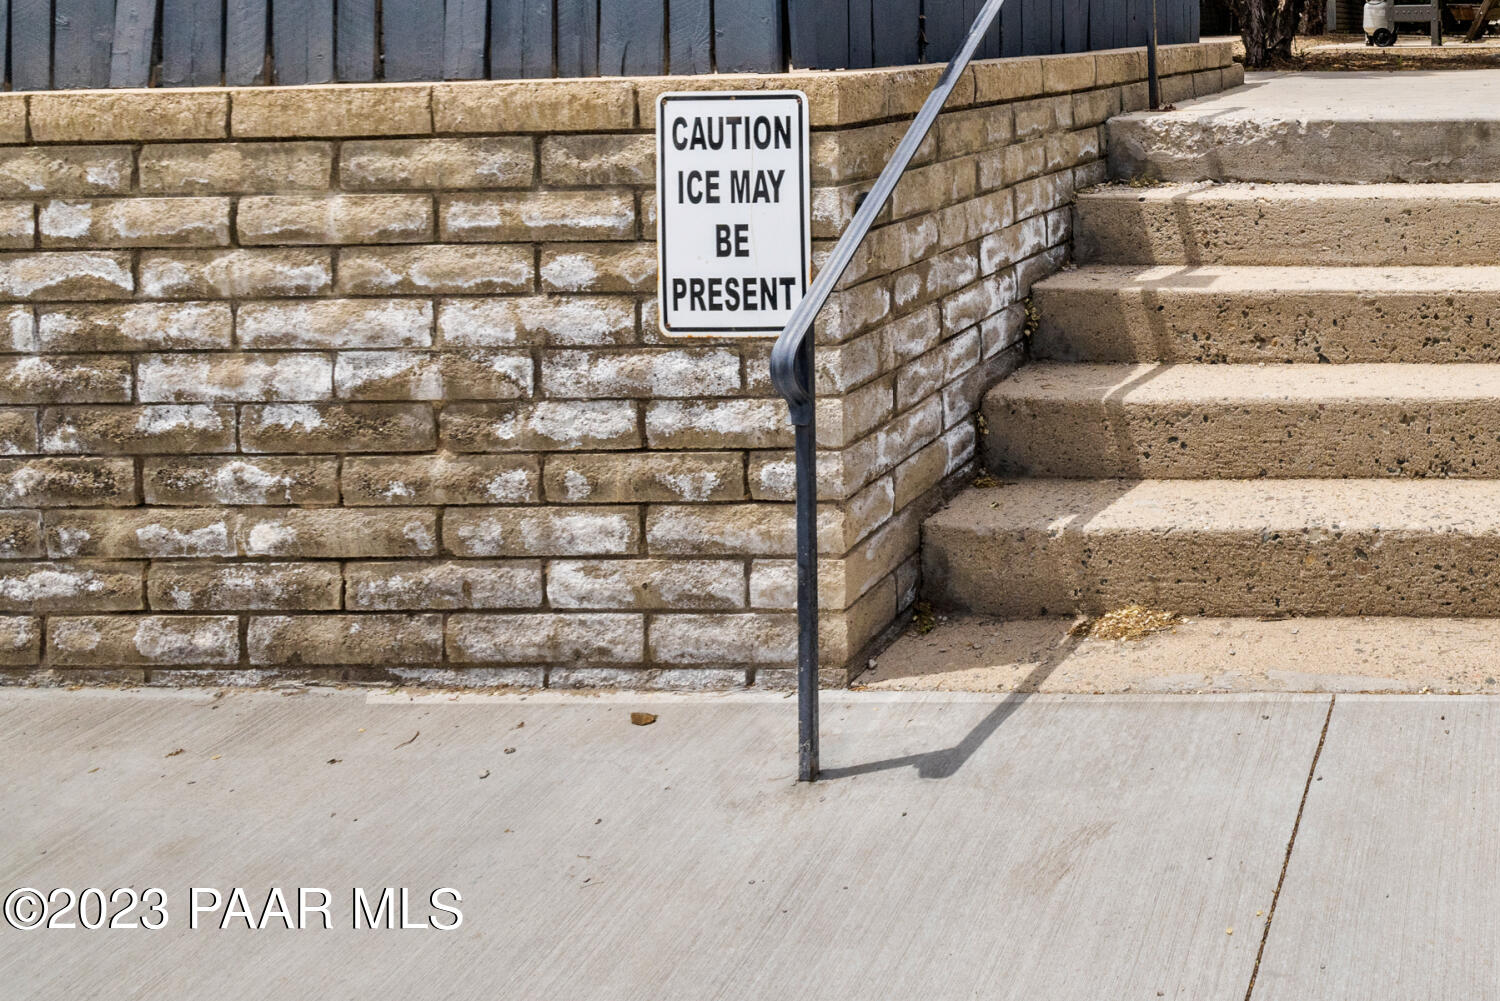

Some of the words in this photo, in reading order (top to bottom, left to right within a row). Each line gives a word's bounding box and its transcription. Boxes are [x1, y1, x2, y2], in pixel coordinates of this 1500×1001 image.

[672, 115, 792, 151] CAUTION
[678, 169, 721, 204] ICE
[730, 169, 786, 204] MAY
[716, 223, 750, 258] BE
[672, 276, 796, 312] PRESENT
